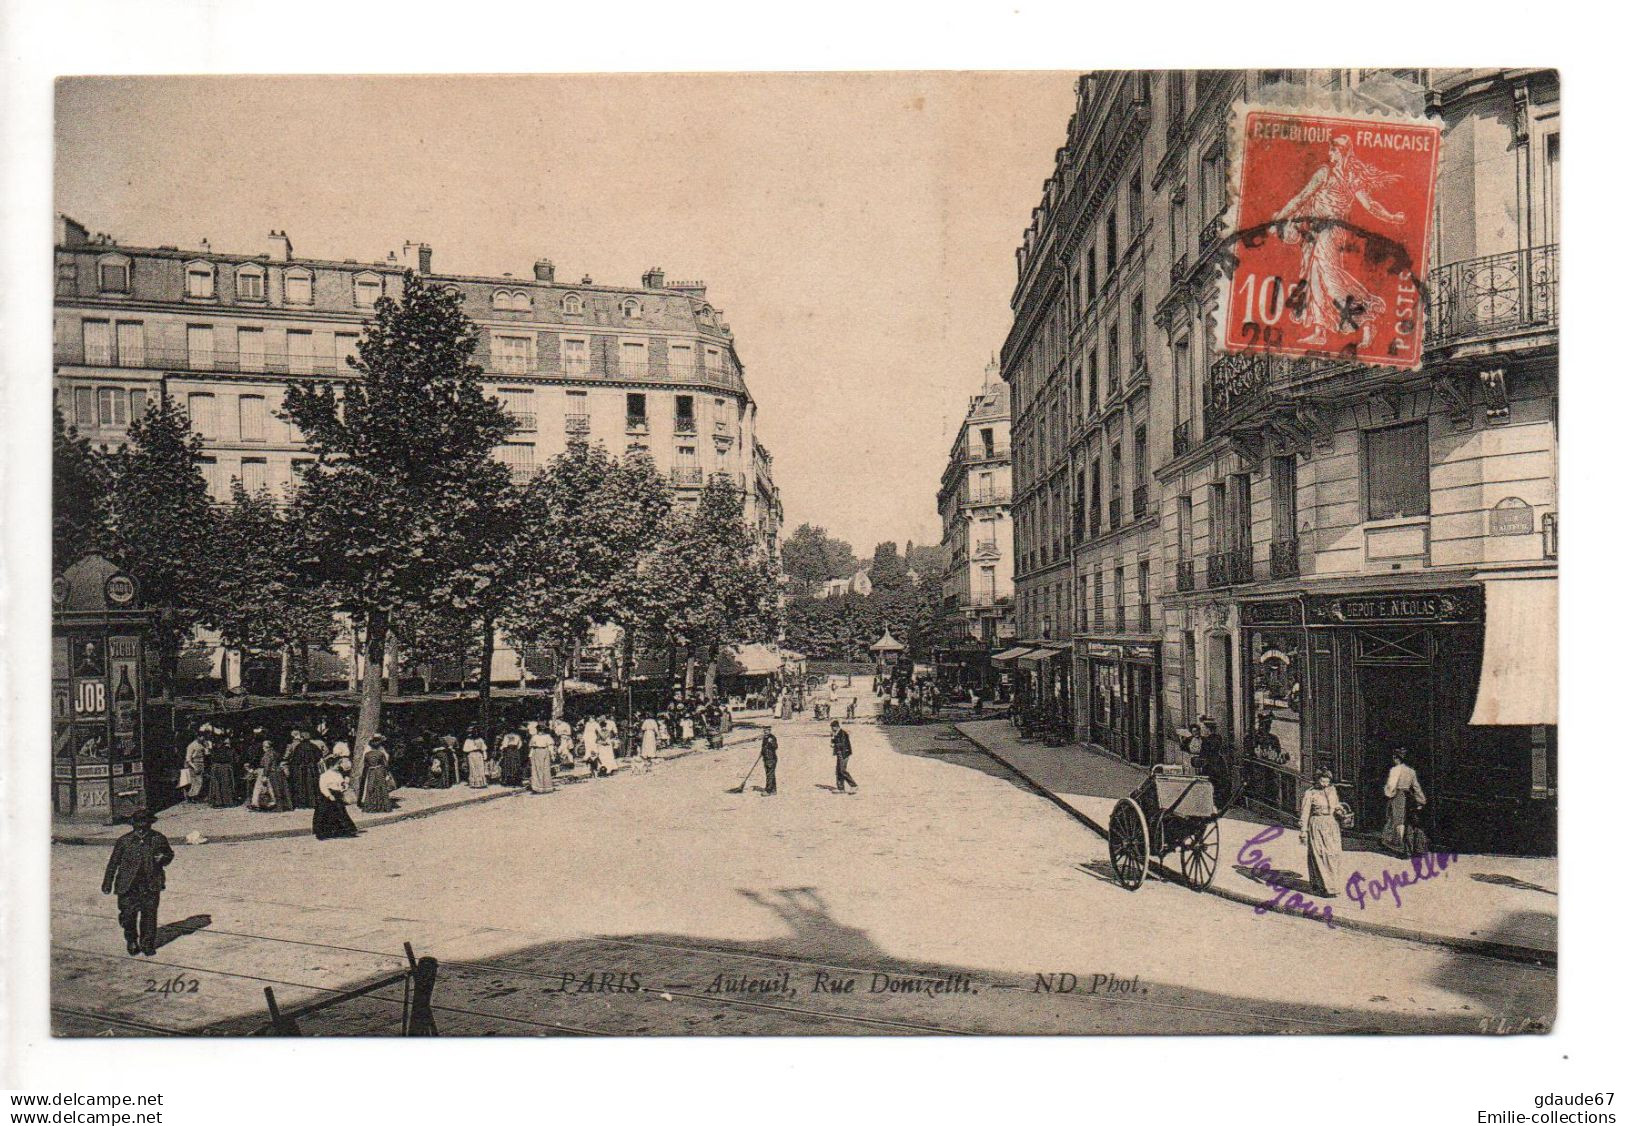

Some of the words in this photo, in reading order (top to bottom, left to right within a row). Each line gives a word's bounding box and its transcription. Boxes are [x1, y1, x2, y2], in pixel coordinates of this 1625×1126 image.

[1356, 131, 1431, 152] FRANÇAISE
[1391, 599, 1435, 616] NICOLAS
[74, 683, 106, 713] JOB
